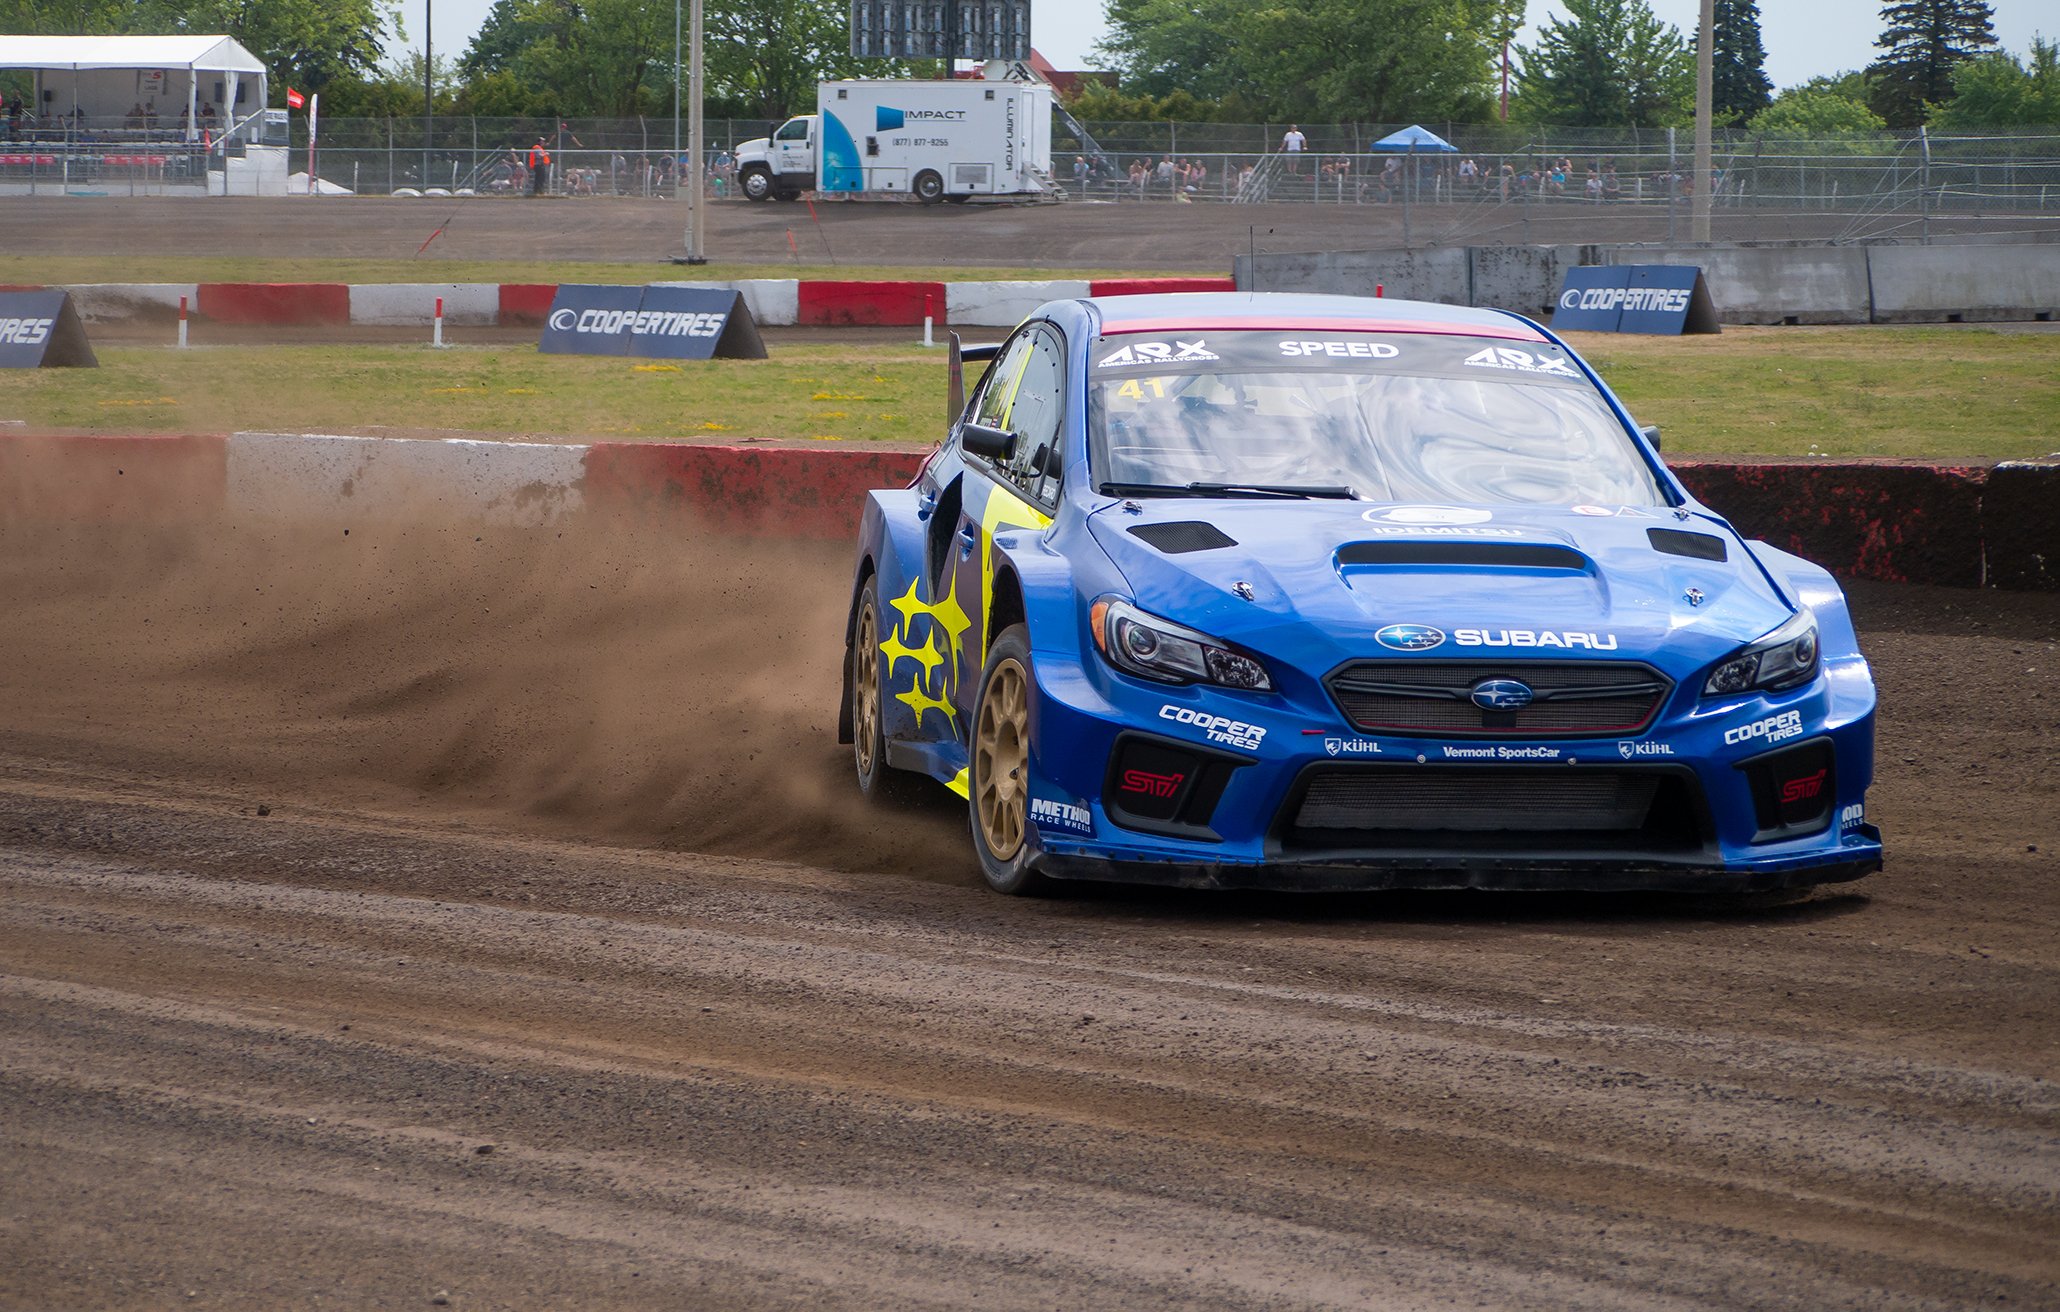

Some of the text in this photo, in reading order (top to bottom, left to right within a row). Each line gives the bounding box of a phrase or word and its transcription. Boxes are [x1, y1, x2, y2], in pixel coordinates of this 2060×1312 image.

[904, 110, 966, 119] IMPACT
[892, 138, 911, 148] (877)
[1005, 98, 1014, 171] ILLUMINATOR
[1099, 339, 1215, 362] ARX
[1278, 341, 1400, 358] SPEED
[1098, 354, 1220, 368] AMERICAS RALLYCROSS
[1463, 346, 1578, 374] ARX
[1463, 361, 1581, 378] AMERICAS RALLYCROSS
[1117, 377, 1166, 400] 41
[1372, 527, 1523, 537] IDEMITSU
[1454, 629, 1618, 650] SUBARU
[1158, 704, 1267, 741] COOPER
[1724, 709, 1801, 745] COOPER
[1206, 729, 1261, 751] TIRES
[1765, 723, 1803, 743] TIRES
[1342, 739, 1383, 753] KÜHL
[1443, 746, 1560, 759] Vermont SportsCar
[1635, 741, 1675, 754] KÜHL
[1031, 798, 1091, 825] METHOD
[1030, 813, 1091, 833] RACE WHEELS
